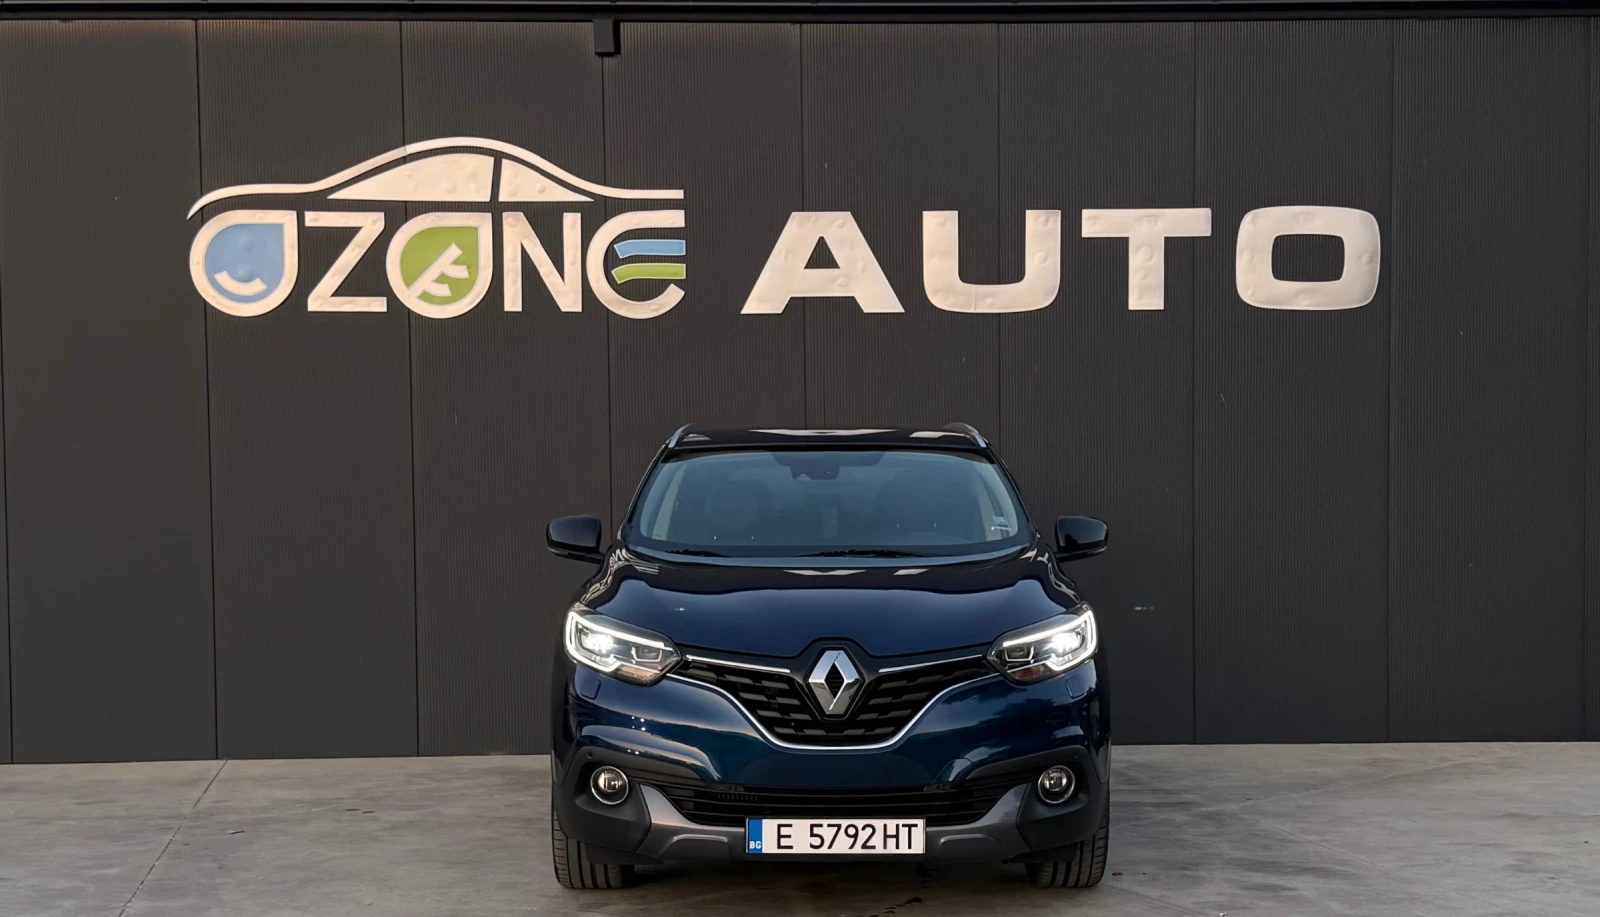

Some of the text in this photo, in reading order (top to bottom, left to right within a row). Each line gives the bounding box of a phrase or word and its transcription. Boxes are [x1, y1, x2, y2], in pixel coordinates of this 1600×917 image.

[189, 205, 1381, 319] OZONE AUTO
[749, 840, 762, 850] BG
[776, 823, 794, 850] E
